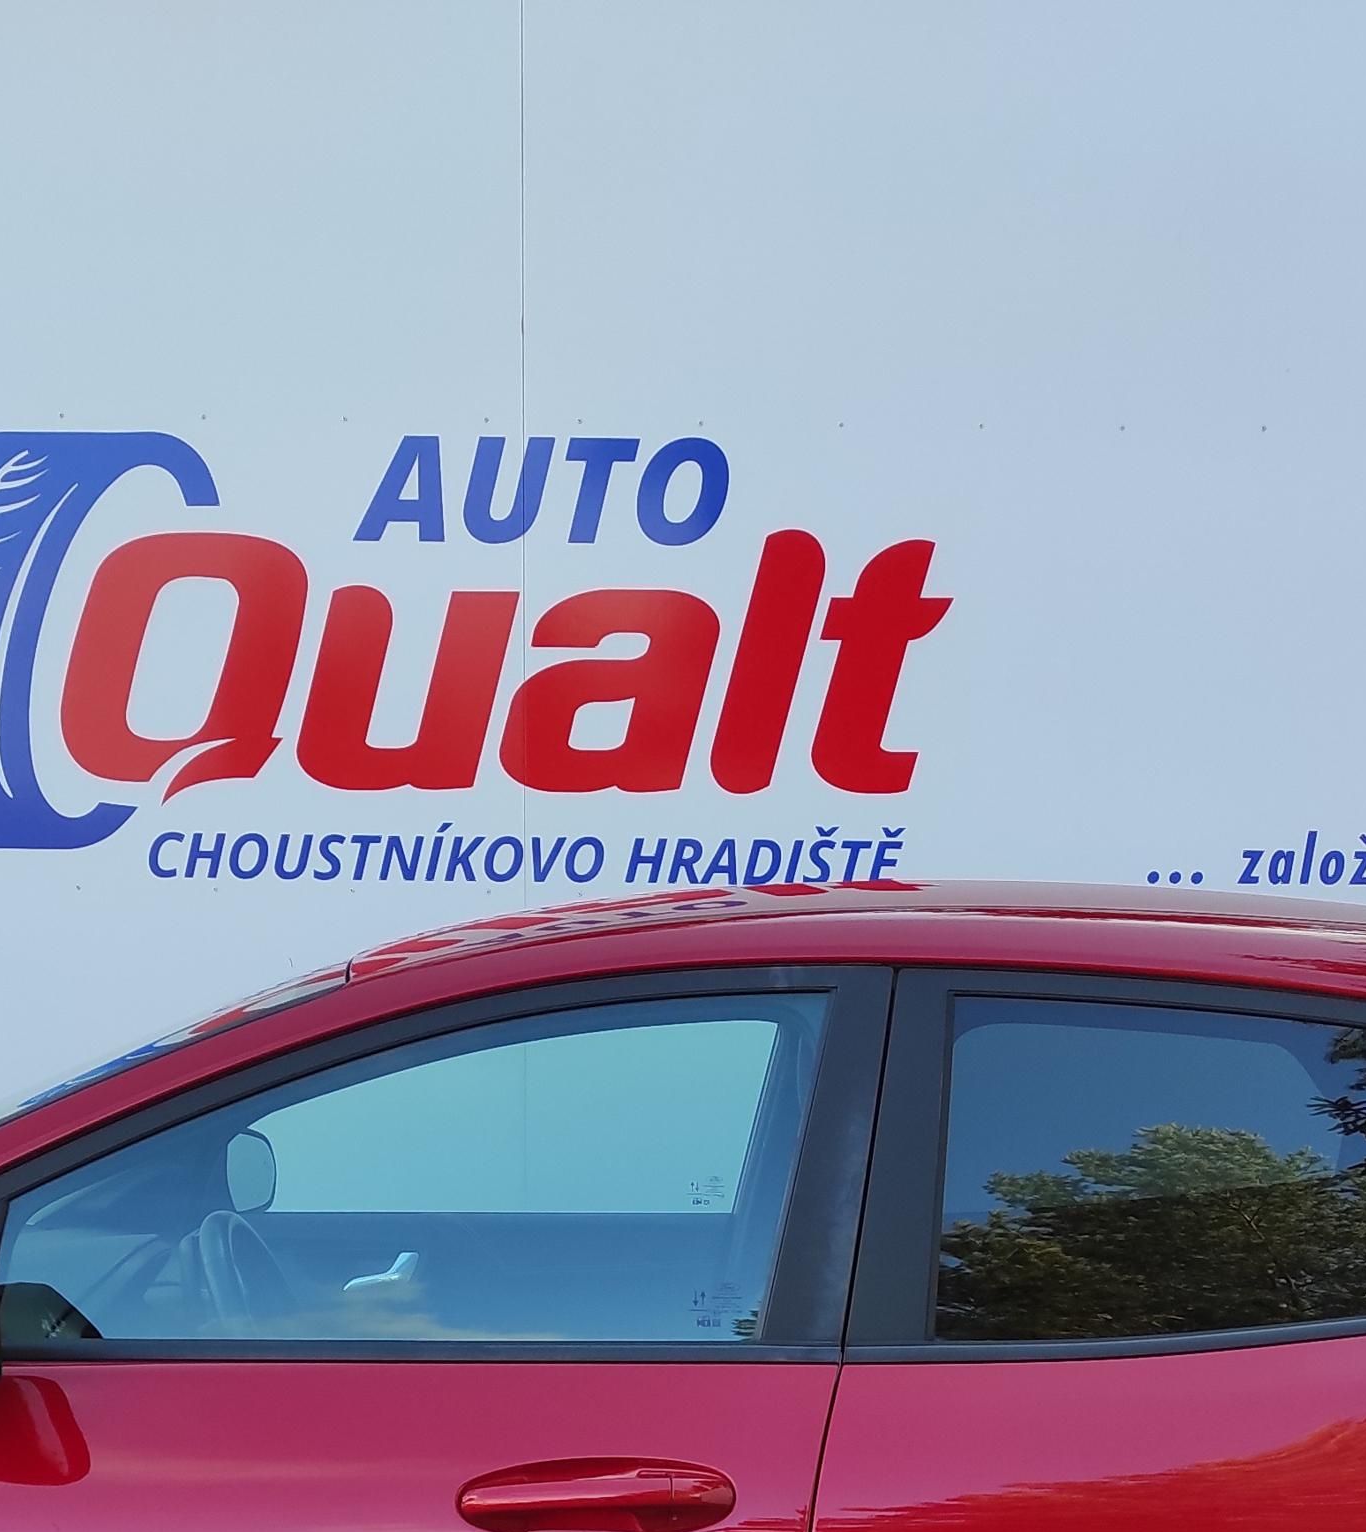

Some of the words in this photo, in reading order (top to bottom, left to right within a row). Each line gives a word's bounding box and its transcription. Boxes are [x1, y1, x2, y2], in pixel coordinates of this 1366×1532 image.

[353, 435, 731, 546] AUTO
[61, 530, 952, 805] Qualt
[148, 822, 605, 884] CHOUSTNÍKOVO
[624, 826, 905, 886] HRADIŠTĚ
